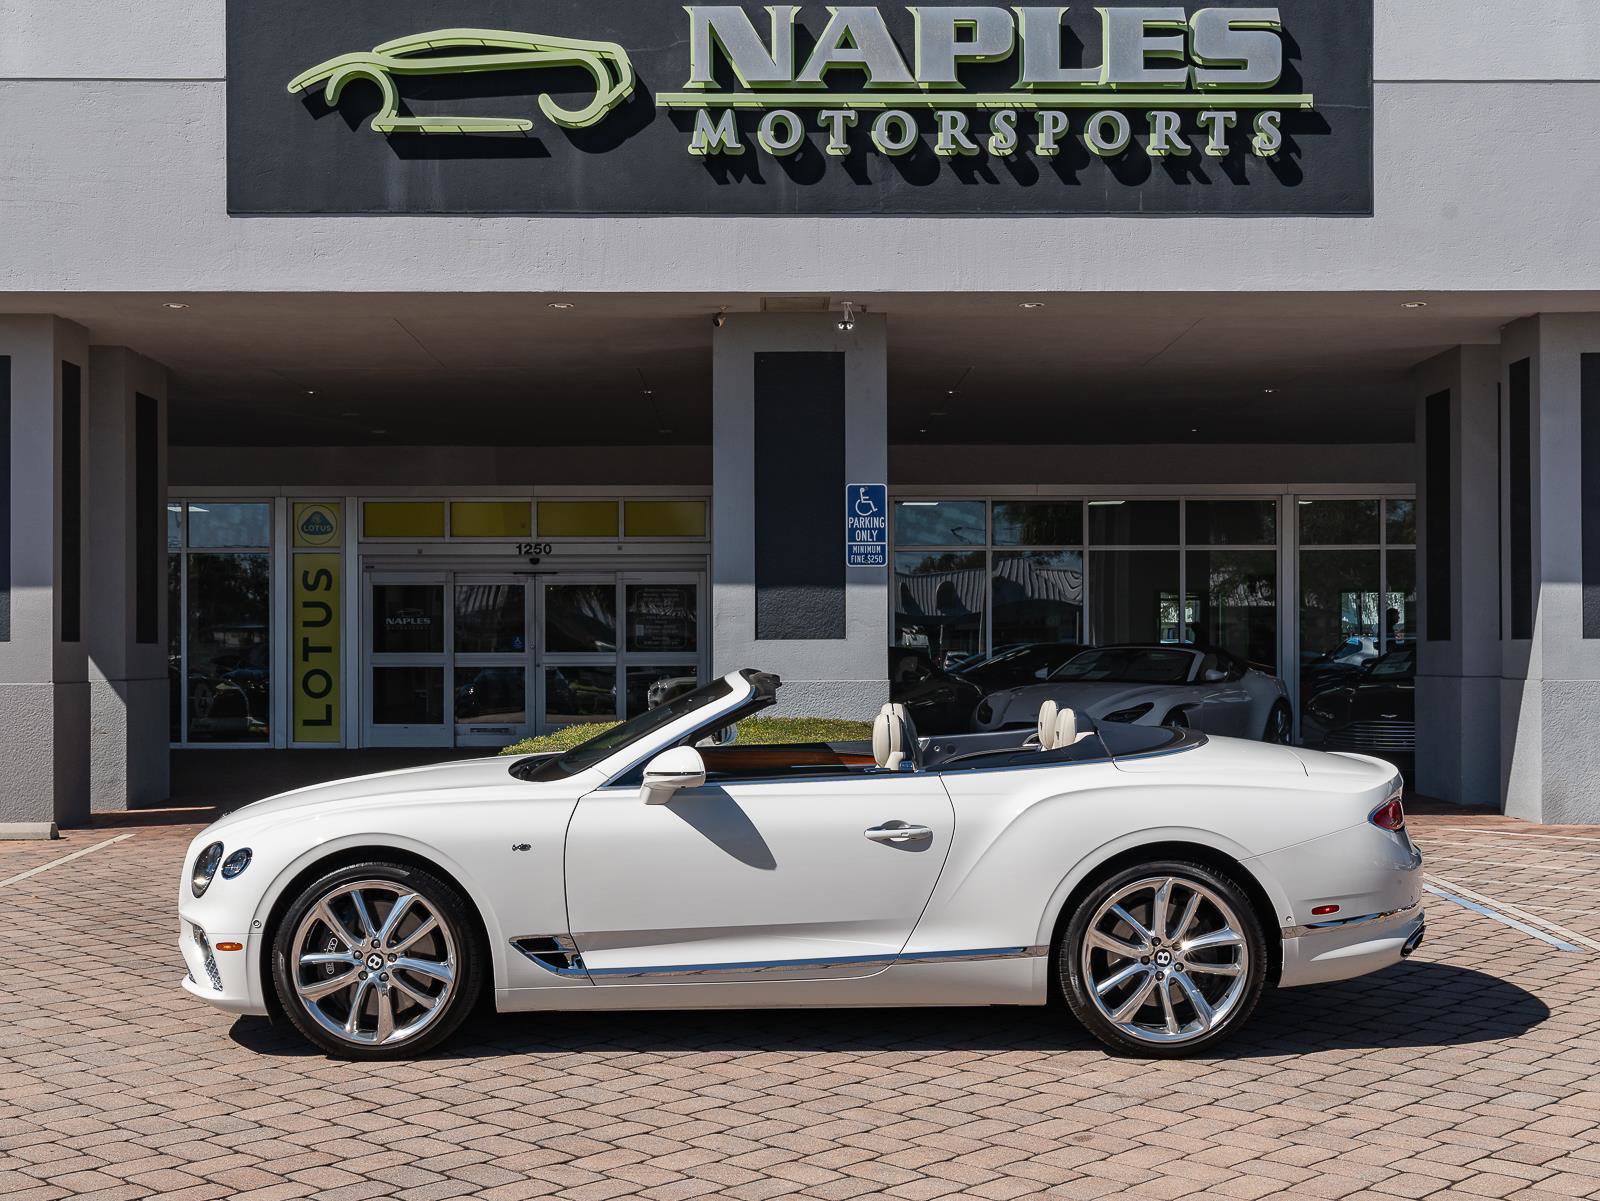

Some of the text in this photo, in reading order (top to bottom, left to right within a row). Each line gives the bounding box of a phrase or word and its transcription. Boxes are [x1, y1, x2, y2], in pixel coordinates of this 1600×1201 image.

[683, 6, 1283, 89] NAPLES
[688, 108, 1283, 156] MOTORSPORTS
[848, 516, 885, 528] PARKING
[303, 524, 332, 533] LOTUS
[855, 529, 878, 541] ONLY
[515, 543, 552, 555] 1250
[852, 545, 881, 554] MINIMUM
[850, 554, 865, 564] FINE
[385, 616, 432, 625] NAPLES
[302, 568, 333, 727] LOTUS
